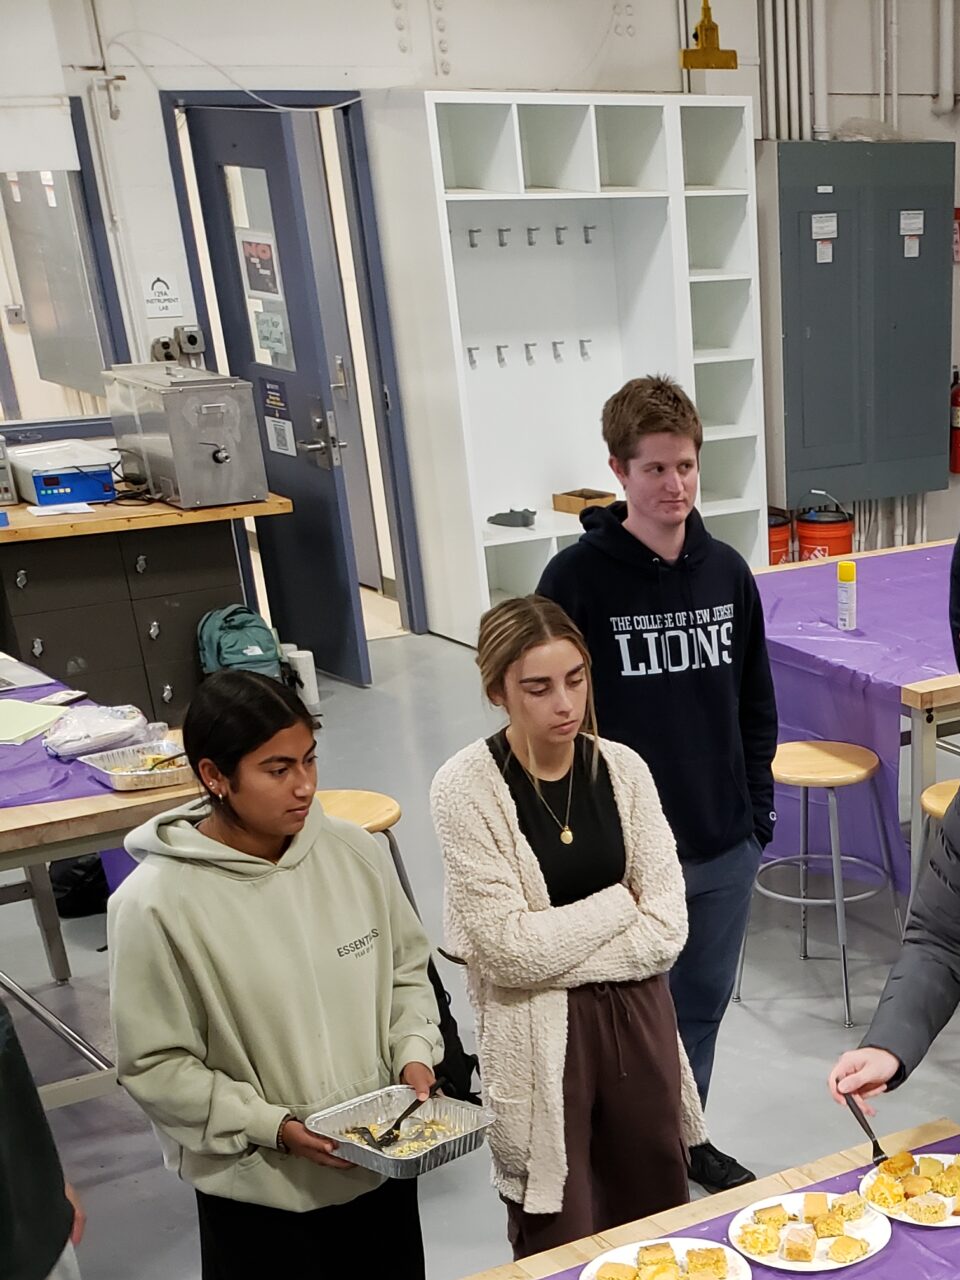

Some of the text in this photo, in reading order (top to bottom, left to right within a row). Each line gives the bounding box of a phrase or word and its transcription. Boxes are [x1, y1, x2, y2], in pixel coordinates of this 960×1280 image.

[242, 241, 272, 261] NO
[610, 617, 632, 631] THE
[675, 611, 687, 626] OF
[614, 621, 733, 676] LIONS
[336, 928, 379, 958] ESSENTS
